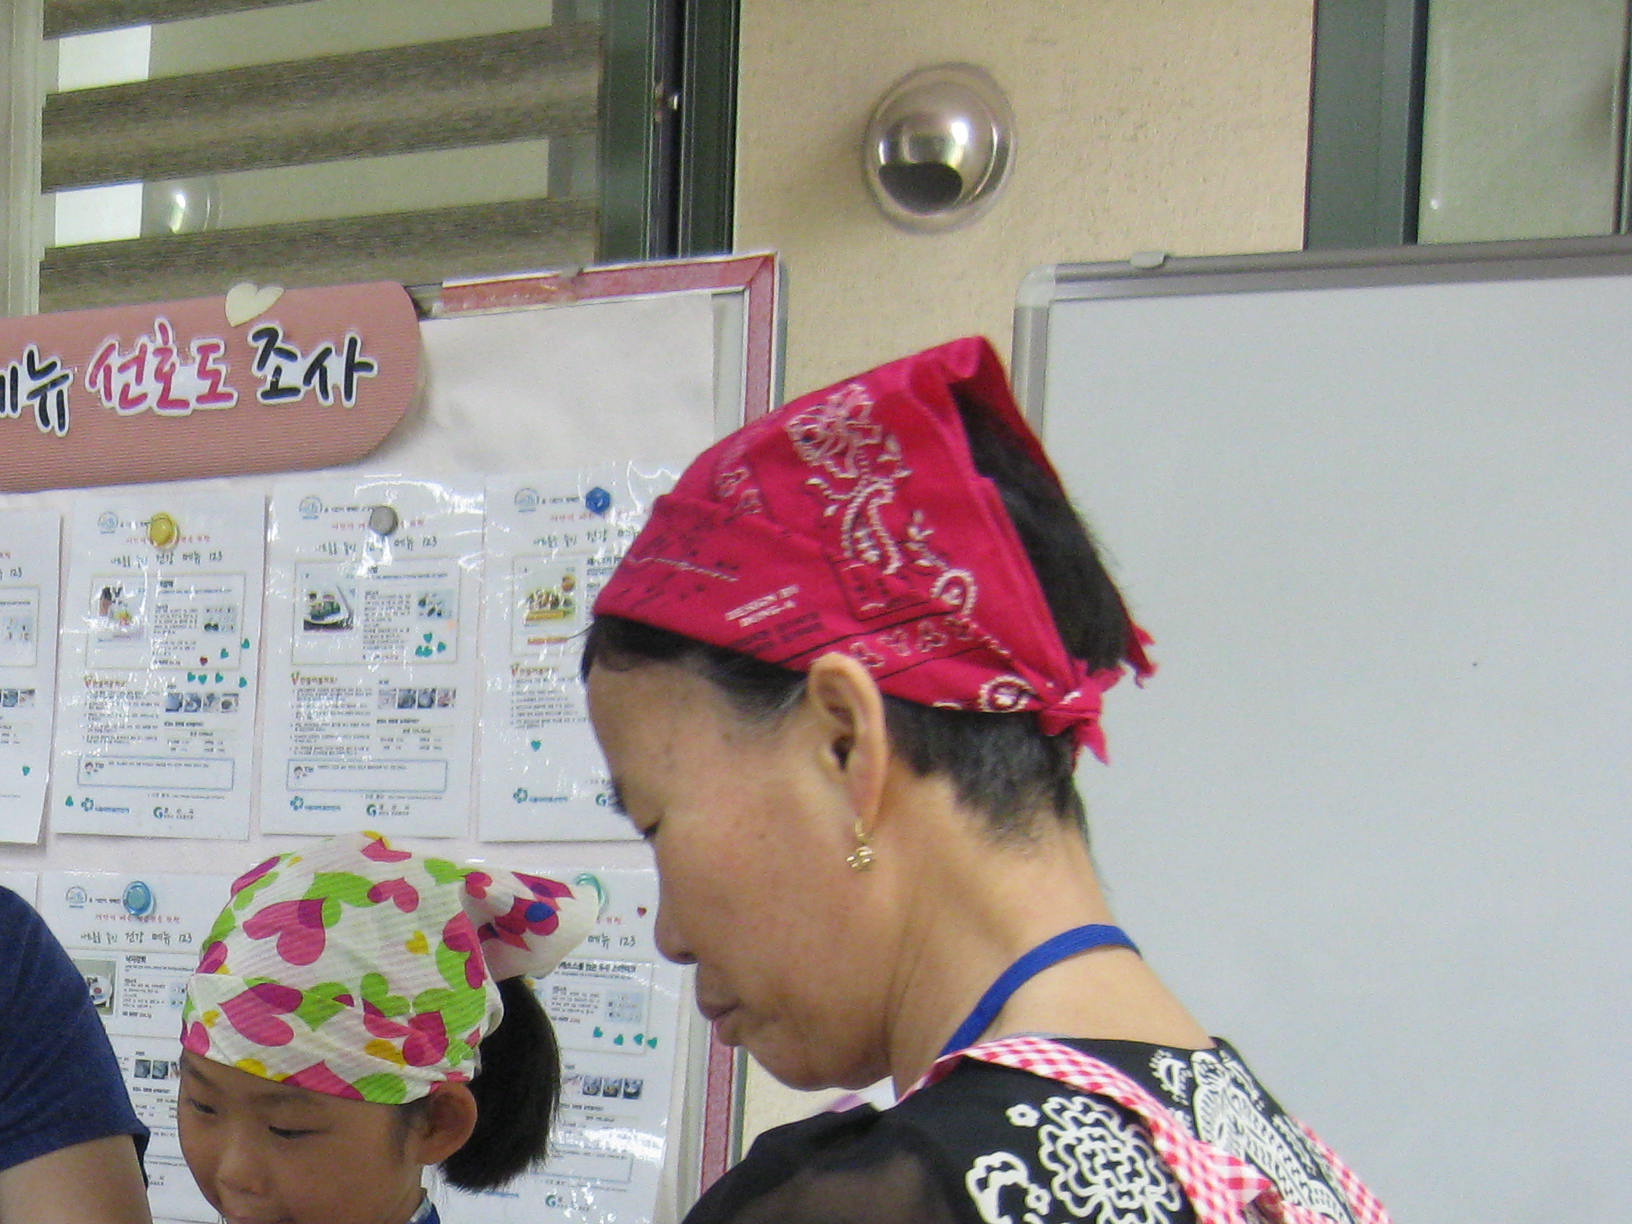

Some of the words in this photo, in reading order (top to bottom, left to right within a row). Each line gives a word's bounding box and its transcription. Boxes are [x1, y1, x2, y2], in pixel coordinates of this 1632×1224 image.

[88, 320, 236, 411] 선호도
[252, 325, 376, 403] 조사
[422, 535, 437, 547] 123
[209, 550, 223, 562] 123
[10, 567, 23, 578] 123
[125, 930, 144, 943] 건강
[151, 930, 171, 946] 메뉴
[178, 932, 193, 943] 123
[587, 932, 611, 949] 메뉴
[619, 936, 636, 947] 123
